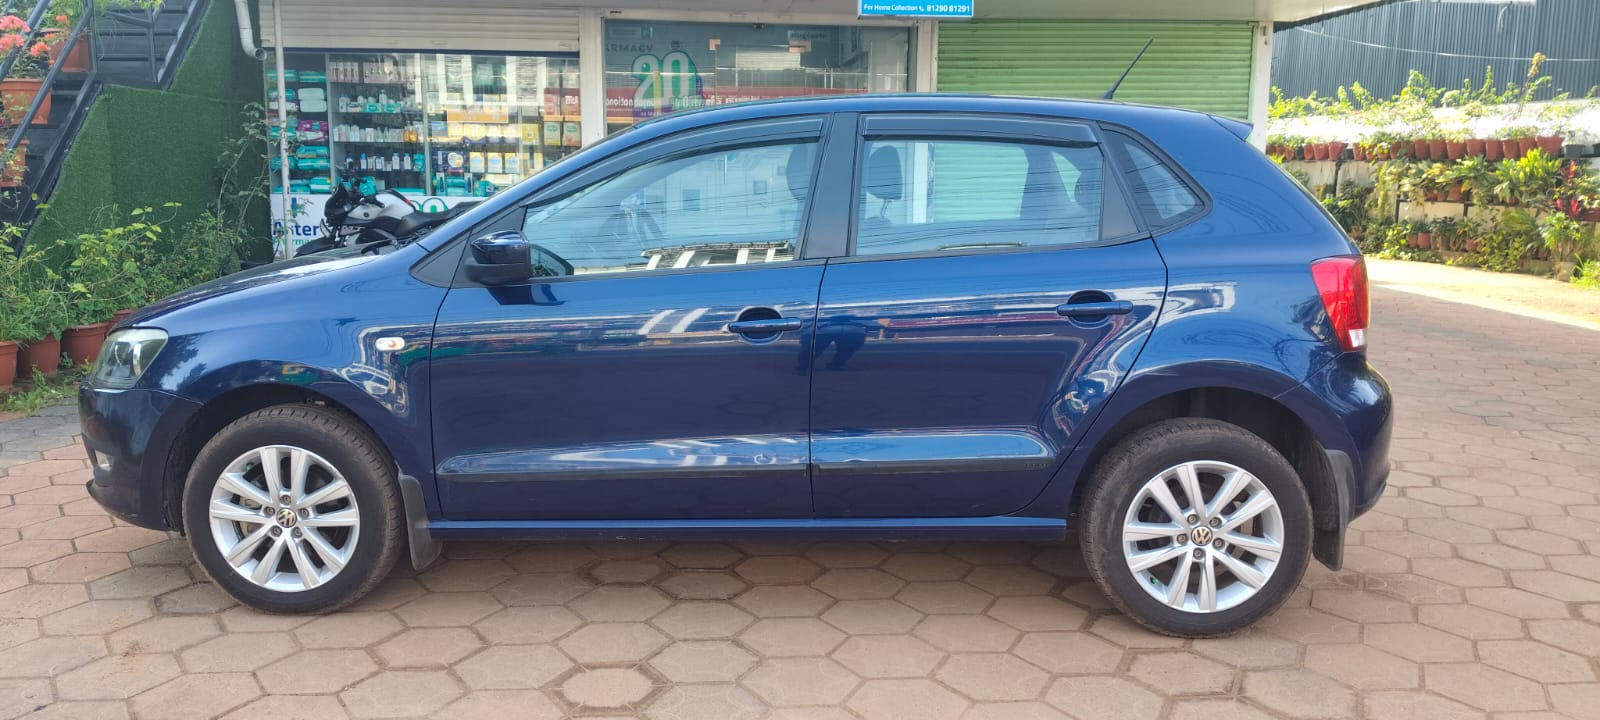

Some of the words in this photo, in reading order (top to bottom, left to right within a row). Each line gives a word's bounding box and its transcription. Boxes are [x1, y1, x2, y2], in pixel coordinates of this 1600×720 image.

[926, 4, 948, 12] 81290
[949, 4, 970, 12] 81291
[272, 221, 320, 237] Ater
